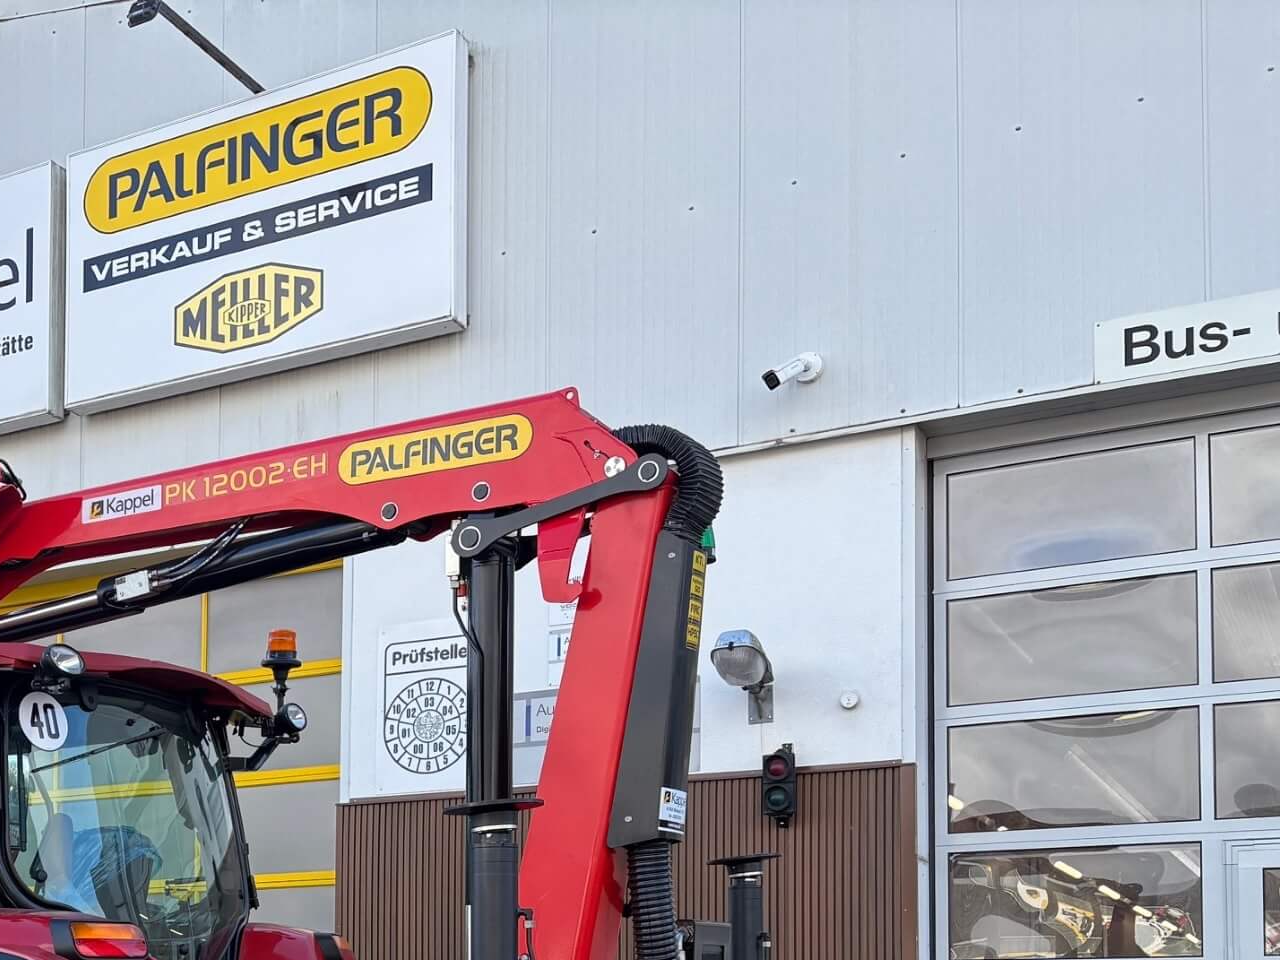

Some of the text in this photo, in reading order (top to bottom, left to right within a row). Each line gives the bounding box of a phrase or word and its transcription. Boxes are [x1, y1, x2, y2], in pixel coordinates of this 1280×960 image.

[108, 87, 402, 220] PALFINGER
[91, 176, 420, 282] VERKAUF & SERVICE
[182, 273, 316, 343] MEILLER
[227, 302, 267, 324] KIPPER
[1124, 321, 1251, 367] Bus-
[350, 423, 518, 478] PALFINGER
[106, 489, 154, 515] Kappel
[165, 479, 197, 505] PK
[392, 644, 467, 666] Prüfstelle
[407, 689, 415, 699] 11
[426, 681, 434, 692] 12
[393, 703, 401, 714] 10
[406, 708, 416, 718] 02
[424, 697, 435, 707] 03
[442, 705, 453, 716] 04
[31, 702, 60, 739] 40
[445, 725, 456, 735] 05
[401, 728, 410, 738] 01
